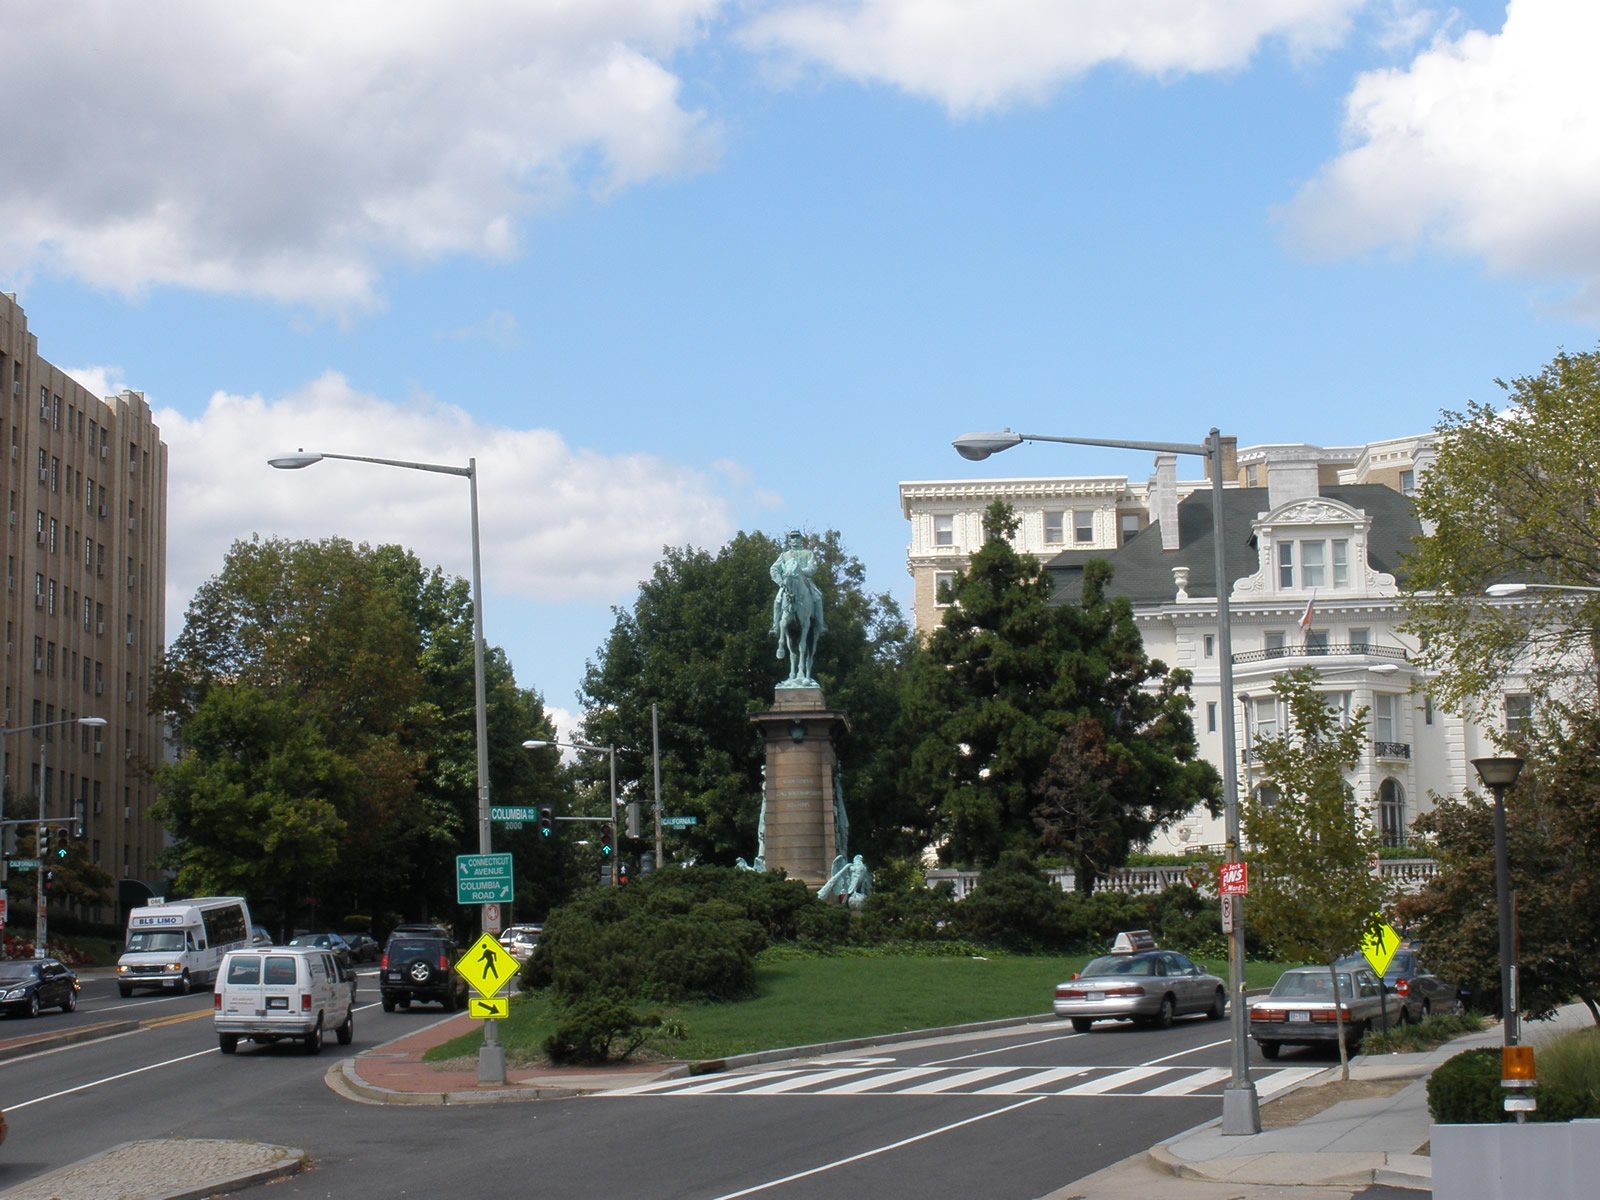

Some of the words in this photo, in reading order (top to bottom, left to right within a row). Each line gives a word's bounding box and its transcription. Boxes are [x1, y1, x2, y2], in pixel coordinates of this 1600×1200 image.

[491, 808, 527, 820] COLUMBIA
[505, 821, 522, 830] 2000
[468, 857, 509, 867] CONNECTICUT
[474, 867, 504, 875] AVENUE
[460, 881, 501, 891] COLUMBIA
[472, 892, 495, 900] ROAD
